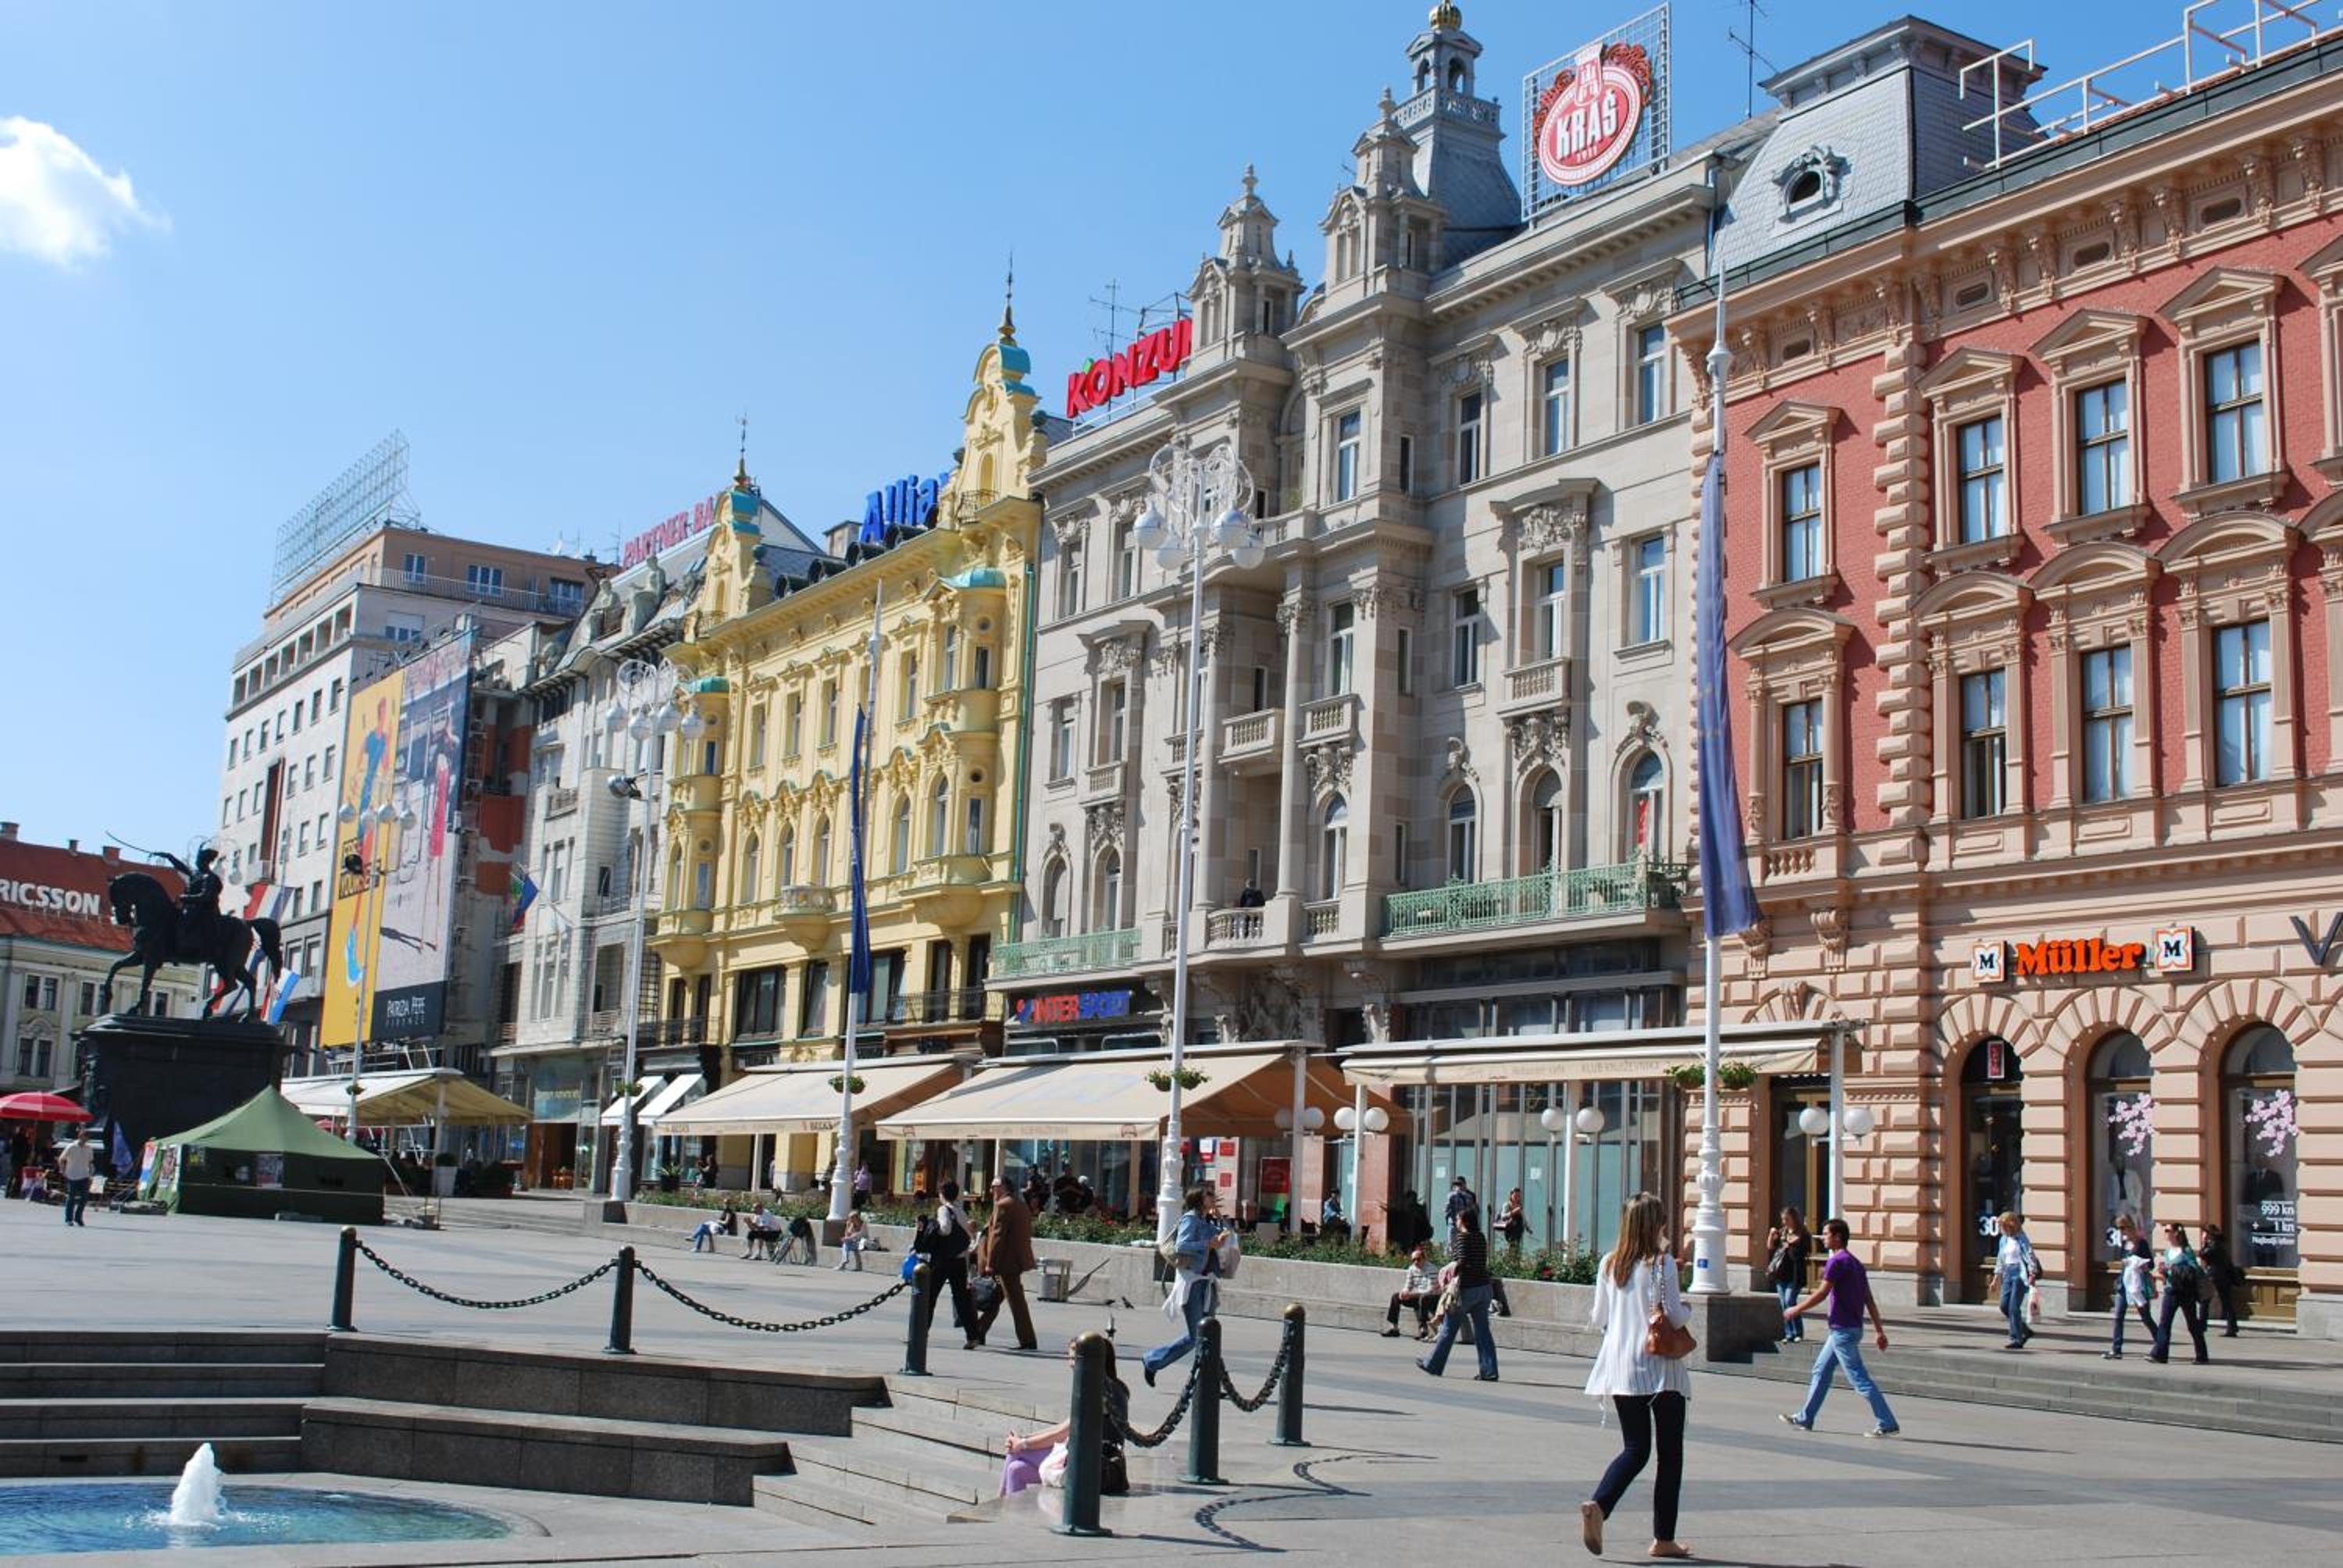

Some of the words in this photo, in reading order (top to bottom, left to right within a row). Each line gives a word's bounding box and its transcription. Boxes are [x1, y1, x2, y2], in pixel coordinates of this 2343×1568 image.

[859, 472, 949, 543] Allia
[0, 878, 100, 916] RICSSON
[2016, 937, 2143, 975] Müller
[2261, 1204, 2280, 1215] 999
[2282, 1204, 2295, 1215] kn
[2282, 1221, 2295, 1231] kn
